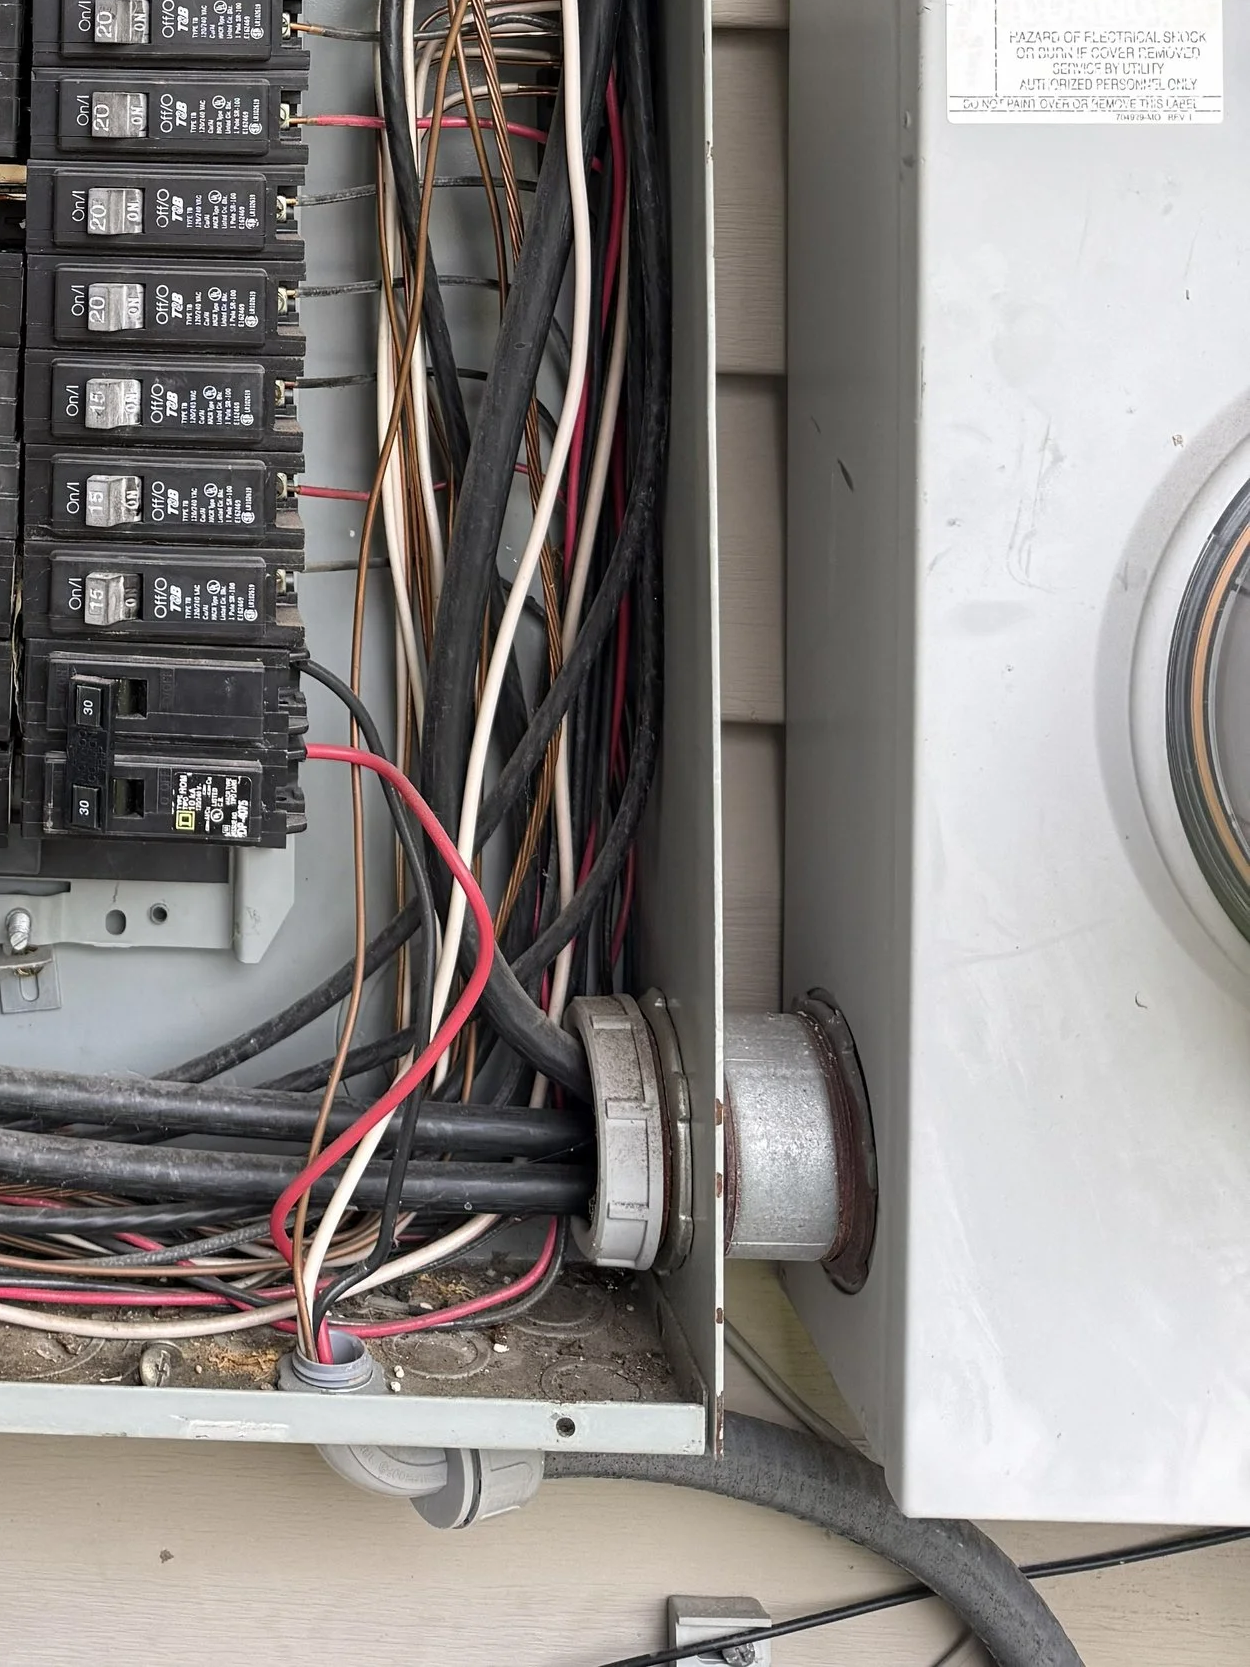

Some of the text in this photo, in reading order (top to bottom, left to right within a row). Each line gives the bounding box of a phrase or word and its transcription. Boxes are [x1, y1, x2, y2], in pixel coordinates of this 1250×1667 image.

[97, 11, 112, 38] 20
[1009, 31, 1060, 43] HAZARD
[1063, 31, 1081, 43] OF
[1084, 31, 1160, 43] ELECTRICAL
[1016, 47, 1034, 59] OR
[1091, 48, 1134, 59] COVER
[1138, 48, 1201, 59] REMOVED
[1105, 63, 1119, 74] BY
[1123, 63, 1164, 74] UTILITY
[1020, 78, 1093, 90] AUTHORIZED
[1167, 79, 1197, 90] ONLY
[963, 99, 979, 109] DO
[1007, 99, 1036, 109] PAINT
[1040, 99, 1070, 109] OVER
[1073, 100, 1089, 109] OR
[1091, 99, 1136, 109] REMOVE
[1140, 99, 1163, 109] THIS
[1167, 99, 1197, 109] LABEL
[93, 105, 110, 131] 20
[90, 205, 107, 231] 20
[90, 296, 105, 323] 20
[89, 491, 103, 516] 15
[89, 588, 104, 615] 15
[84, 700, 93, 715] 30
[80, 801, 89, 815] 30
